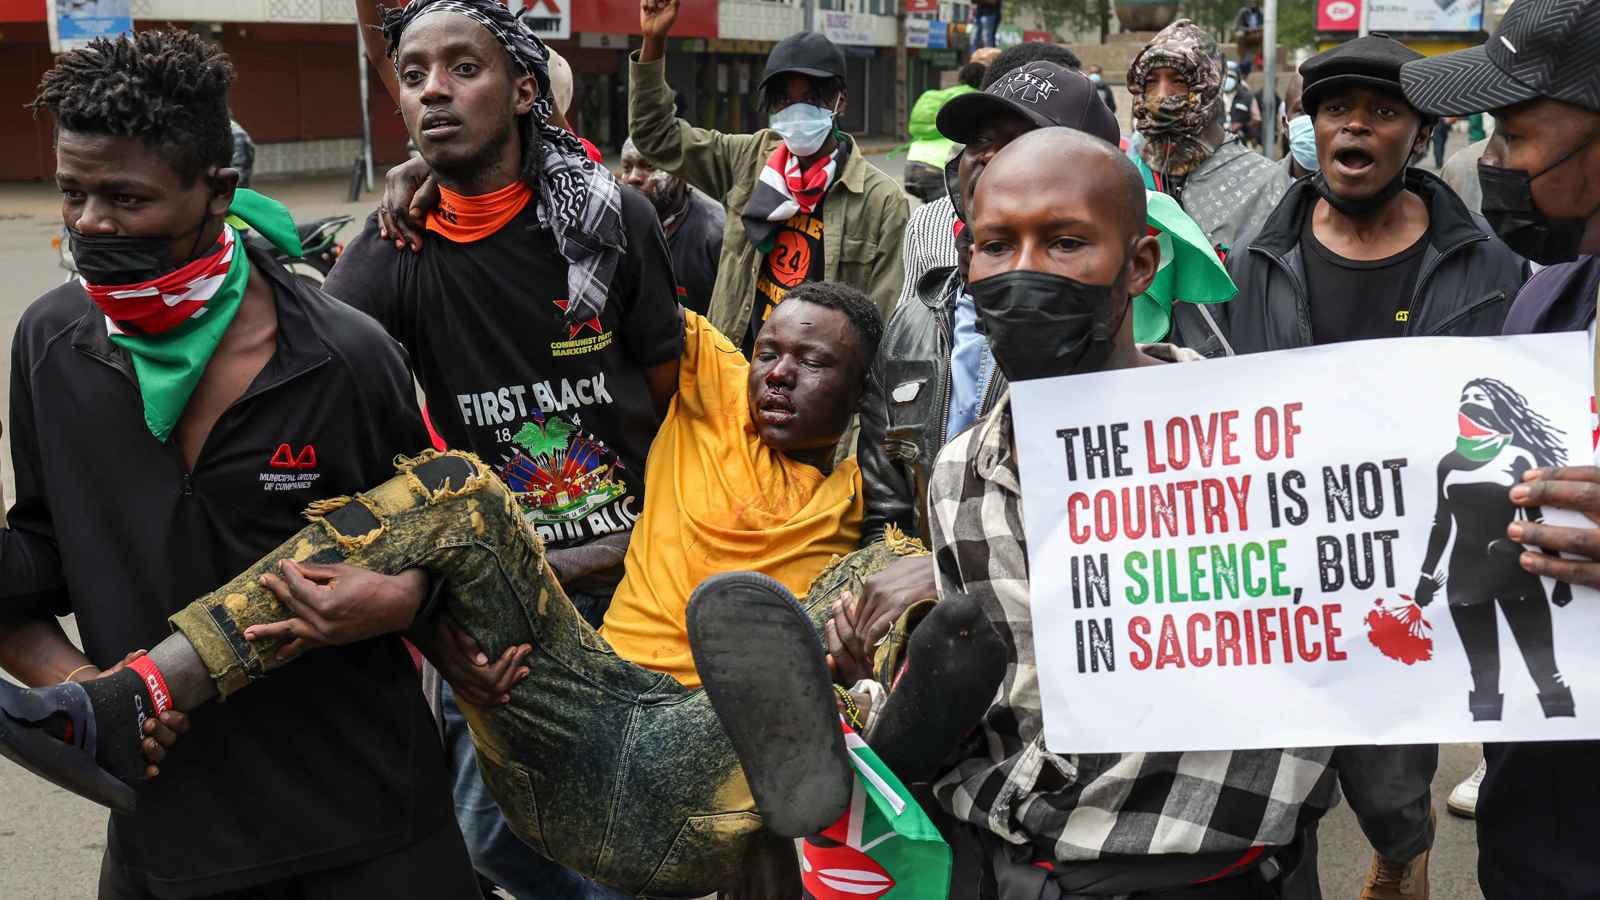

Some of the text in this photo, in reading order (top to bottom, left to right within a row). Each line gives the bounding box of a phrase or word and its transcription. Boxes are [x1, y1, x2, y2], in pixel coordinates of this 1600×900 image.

[776, 244, 801, 272] 24
[551, 336, 596, 349] COMMUNIST
[456, 371, 613, 426] FIRST BLACK
[495, 428, 511, 443] 18
[1056, 402, 1303, 482] THE LOVE OF
[259, 473, 297, 482] MUNICIPAL
[264, 481, 312, 491] OF COMPANIES
[1067, 458, 1408, 545] COUNTRY IS NOT
[1070, 529, 1400, 609] IN SILENCE, BUT
[1074, 604, 1347, 674] IN SACRIFICE
